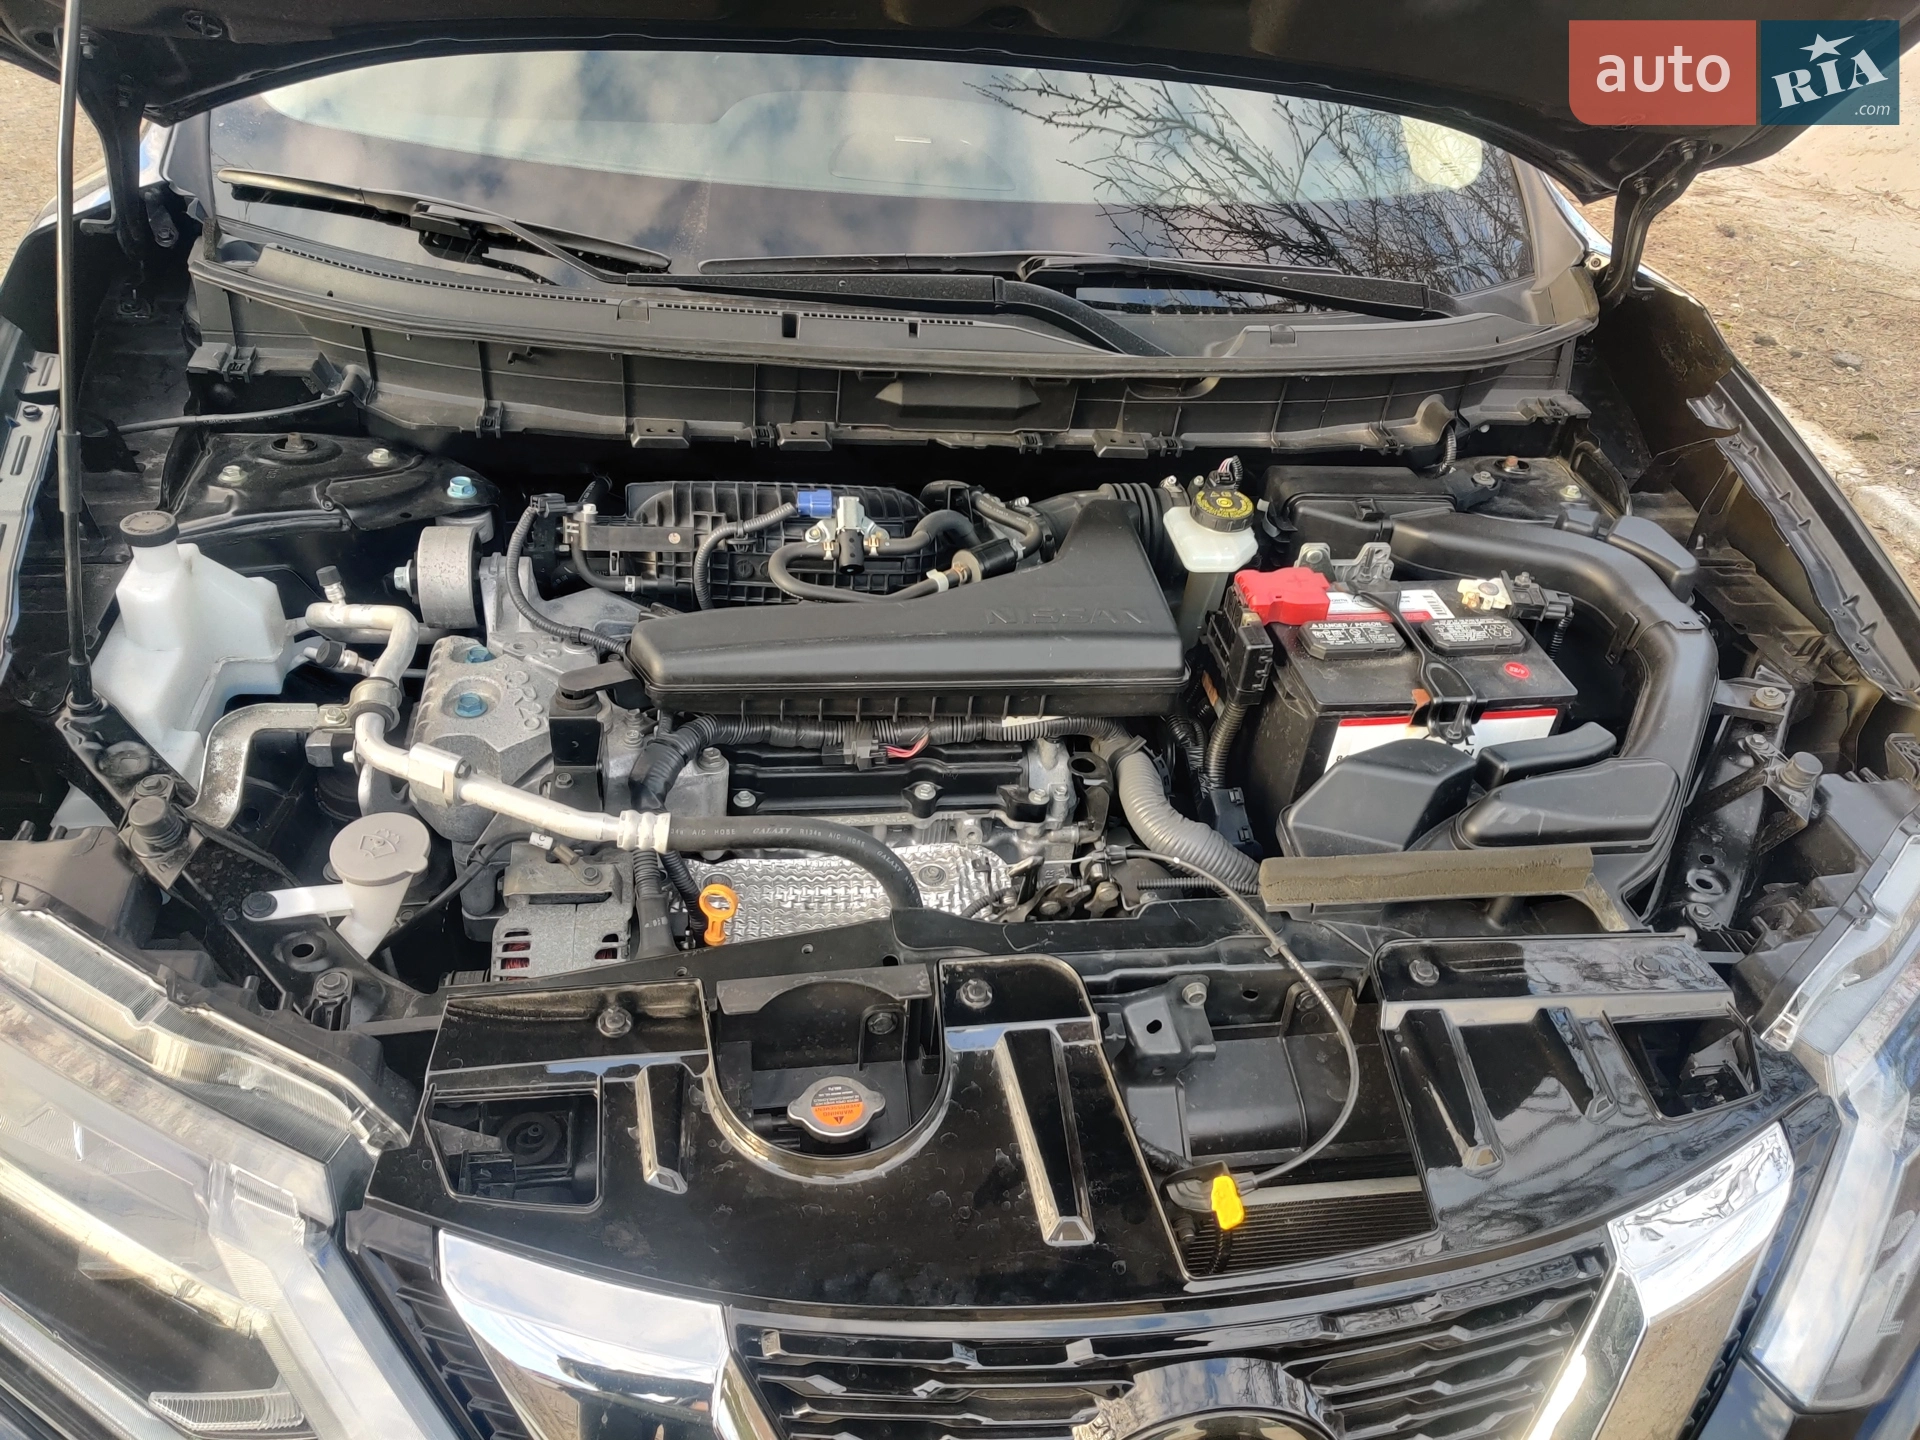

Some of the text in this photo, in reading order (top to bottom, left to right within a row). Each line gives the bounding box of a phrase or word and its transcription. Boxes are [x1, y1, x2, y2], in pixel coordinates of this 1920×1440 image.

[985, 606, 1151, 625] NISSAN
[692, 828, 706, 836] A/C
[752, 827, 792, 835] GALAXY
[800, 828, 821, 837] R134a
[828, 832, 841, 840] A/C
[846, 836, 866, 848] HOSE
[876, 850, 902, 873] GALAXY
[814, 1104, 860, 1112] AVERTISSEMENT
